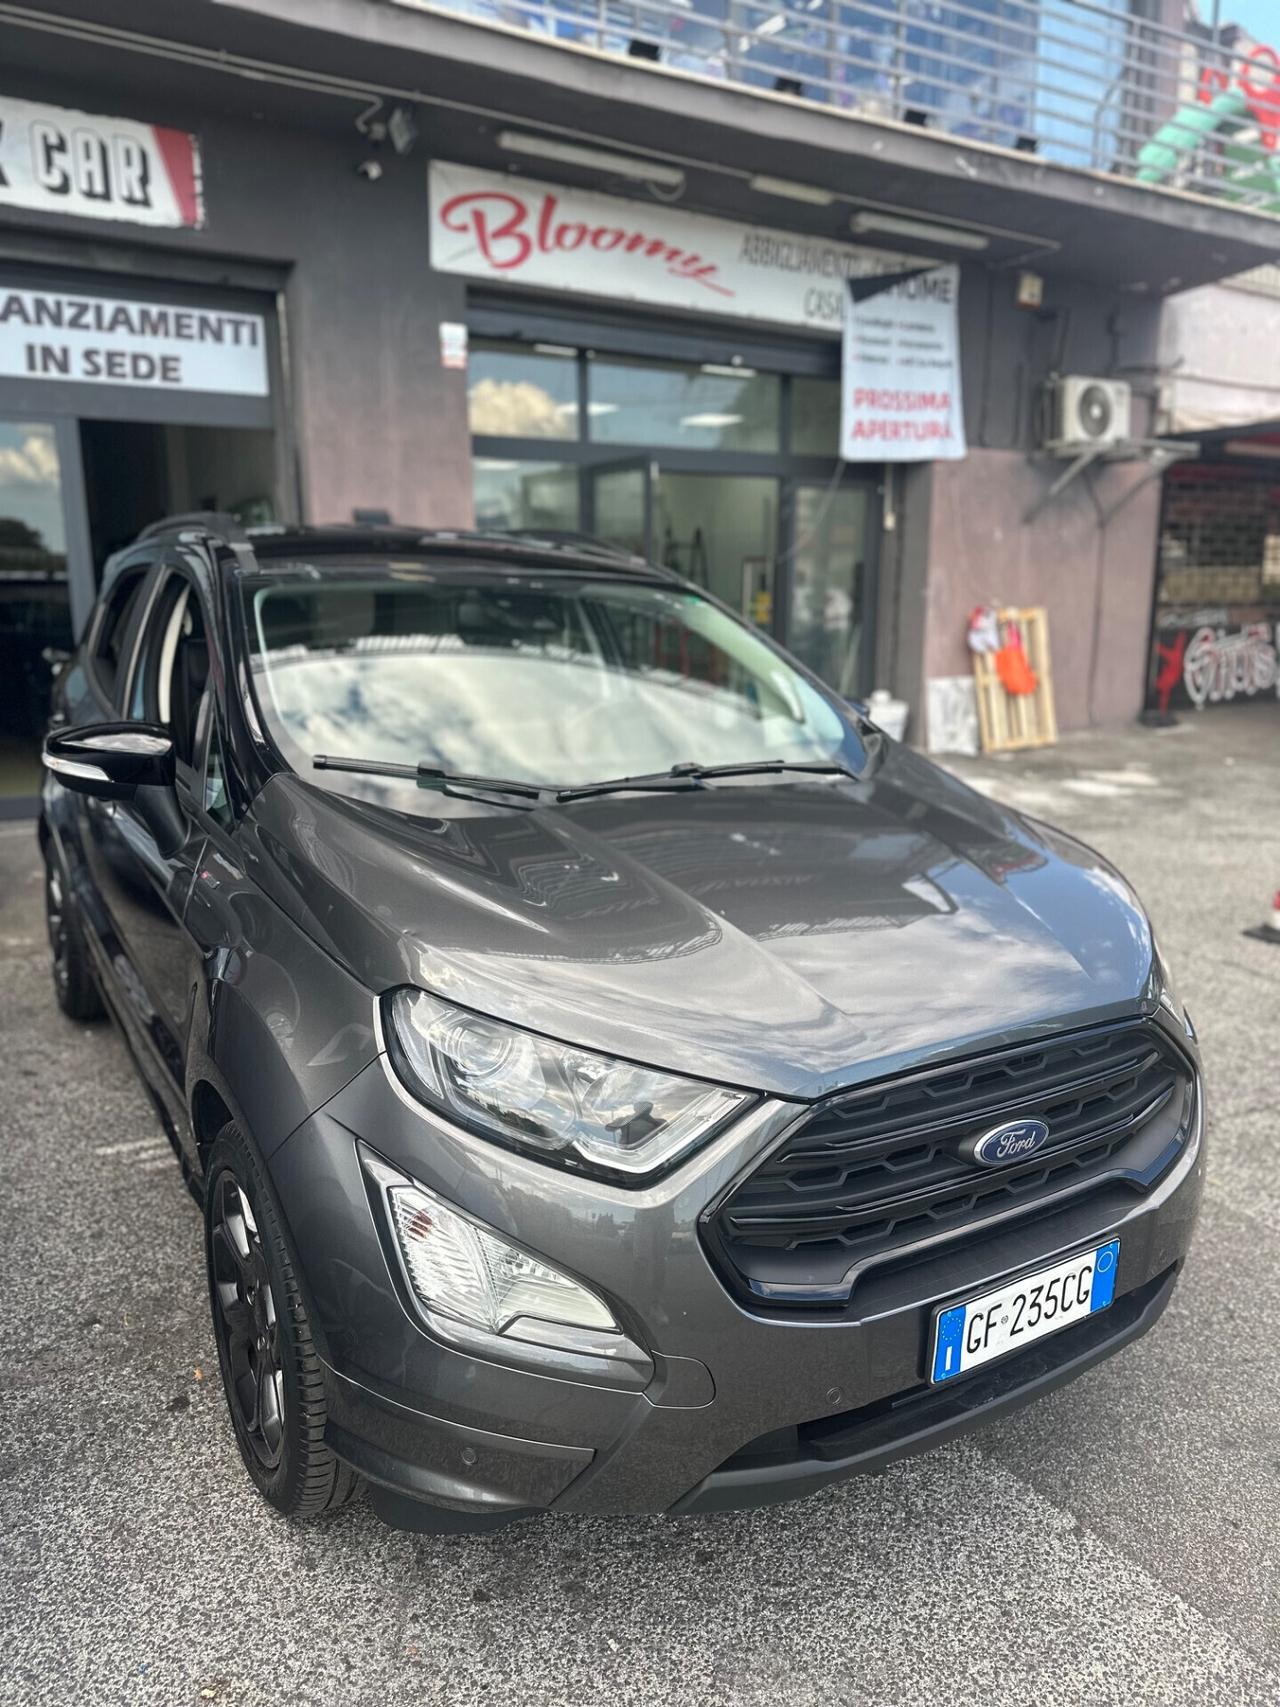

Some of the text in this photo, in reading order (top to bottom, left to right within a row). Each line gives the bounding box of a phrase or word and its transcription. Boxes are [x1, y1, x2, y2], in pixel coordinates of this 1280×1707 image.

[29, 119, 153, 208] CAR
[439, 192, 736, 297] Bloomy
[25, 342, 183, 384] IN SEDE
[854, 387, 952, 411] PROSSIMA
[852, 418, 954, 440] APERTURA
[997, 1128, 1036, 1158] Ford
